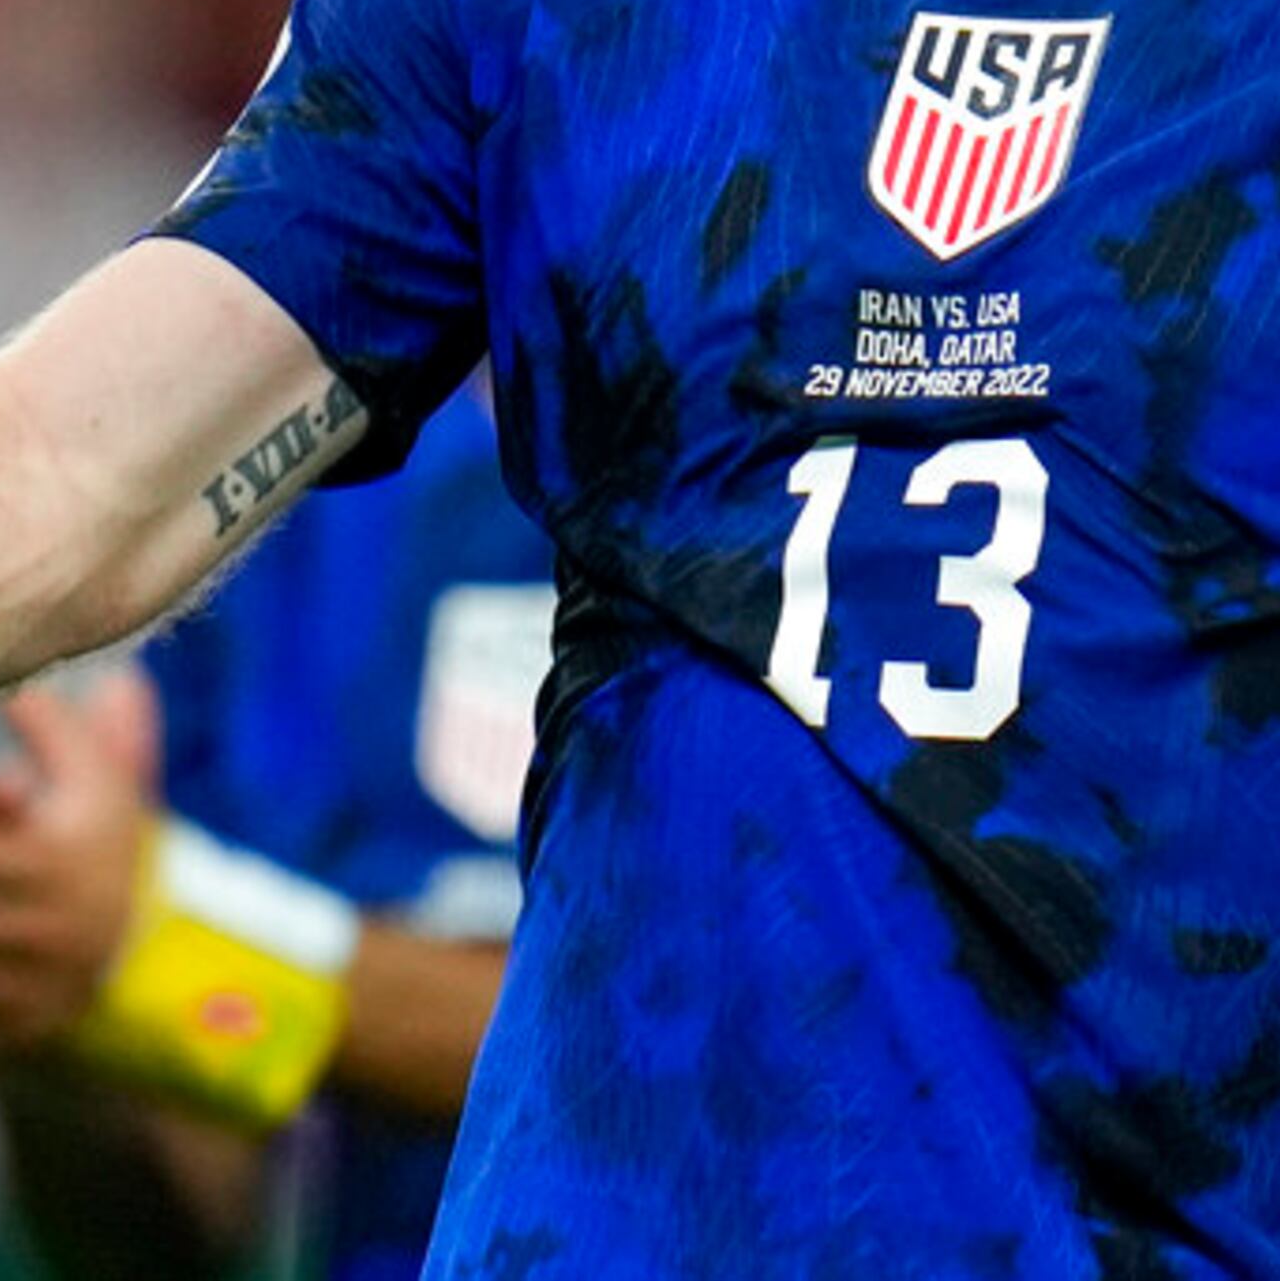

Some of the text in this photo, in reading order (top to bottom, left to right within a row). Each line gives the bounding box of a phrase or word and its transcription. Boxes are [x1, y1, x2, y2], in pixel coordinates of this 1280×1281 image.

[913, 26, 1092, 121] USA
[859, 289, 1020, 329] IRAN VS. USA
[856, 329, 1016, 368] DOHA, QATAR
[804, 363, 1051, 397] 29 NOVEMBER 2022
[760, 435, 1050, 742] 13
